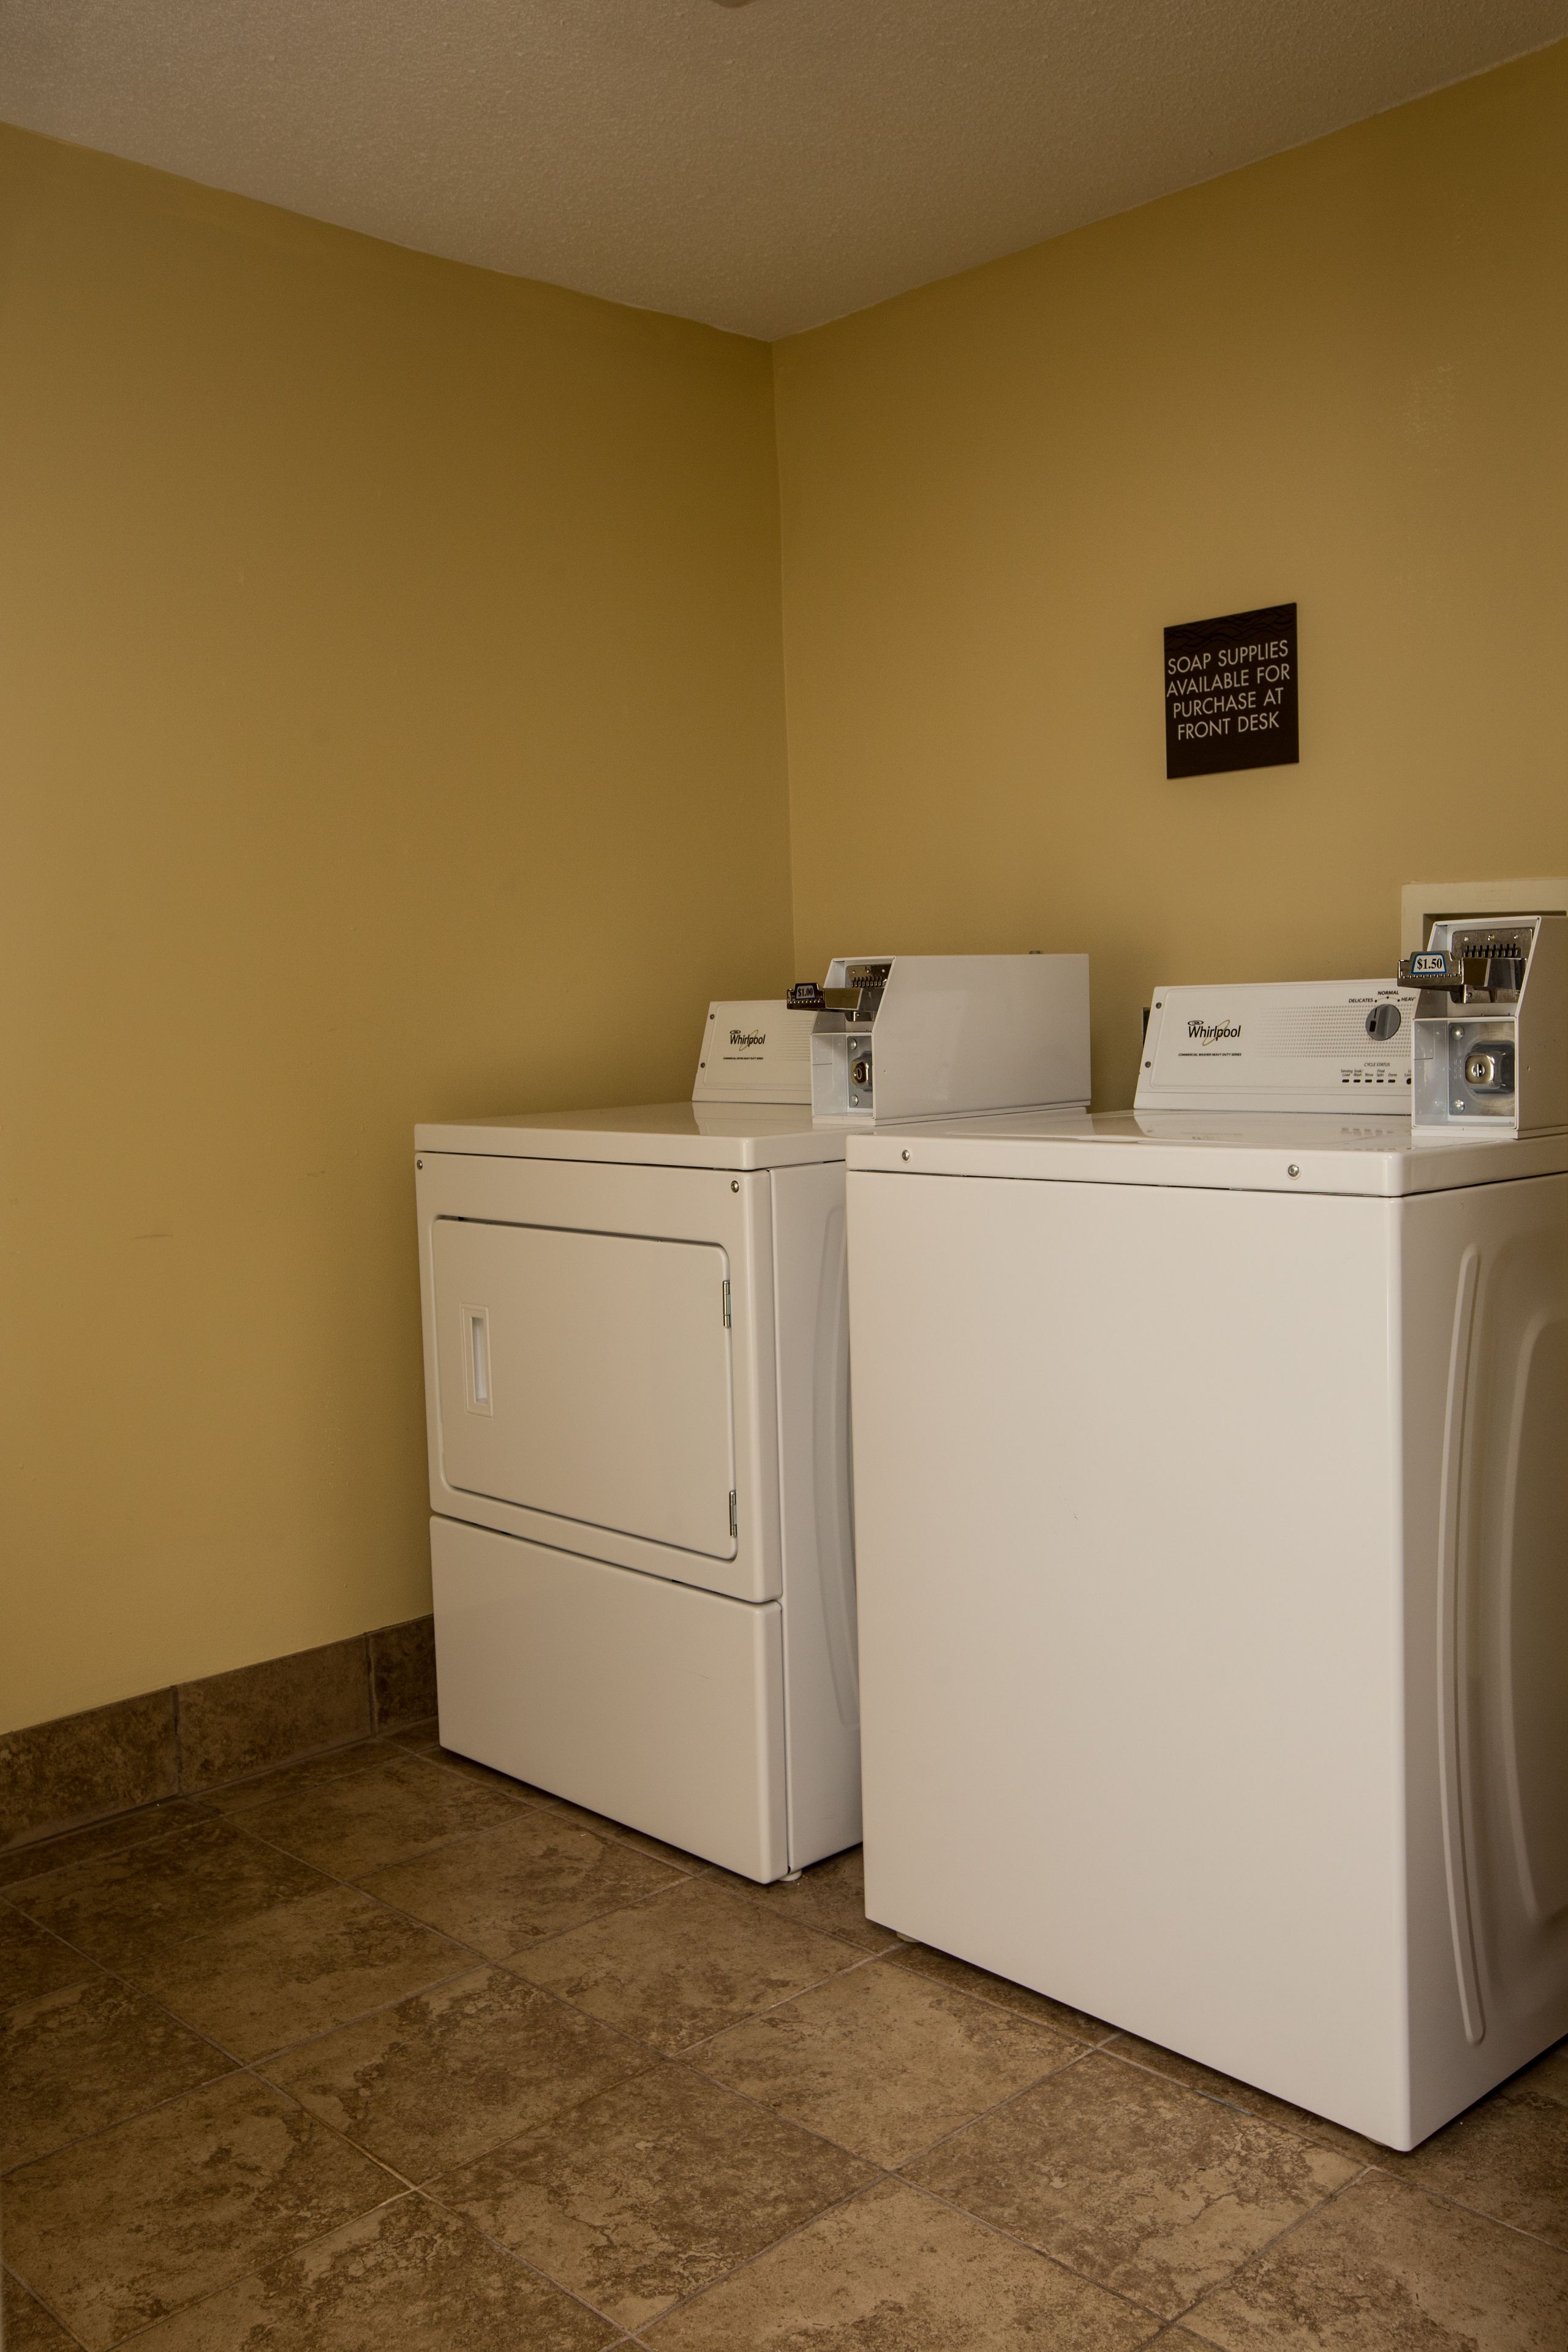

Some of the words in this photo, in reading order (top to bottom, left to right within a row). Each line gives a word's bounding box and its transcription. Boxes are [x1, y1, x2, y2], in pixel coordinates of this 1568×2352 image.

[1167, 653, 1211, 674] SOAP
[1218, 639, 1288, 666] SUPPLIES
[1166, 669, 1249, 697] AVAILABLE
[1257, 663, 1290, 684] FOR
[1174, 691, 1256, 718] PURCHASE
[1264, 687, 1284, 706] AT
[1178, 718, 1231, 741] FRONT
[1238, 711, 1280, 733] DESK
[1417, 958, 1442, 970] $1.50
[798, 988, 813, 997] $1.00
[730, 1034, 766, 1047] Whirlpool
[1188, 1025, 1242, 1041] Whirlpool
